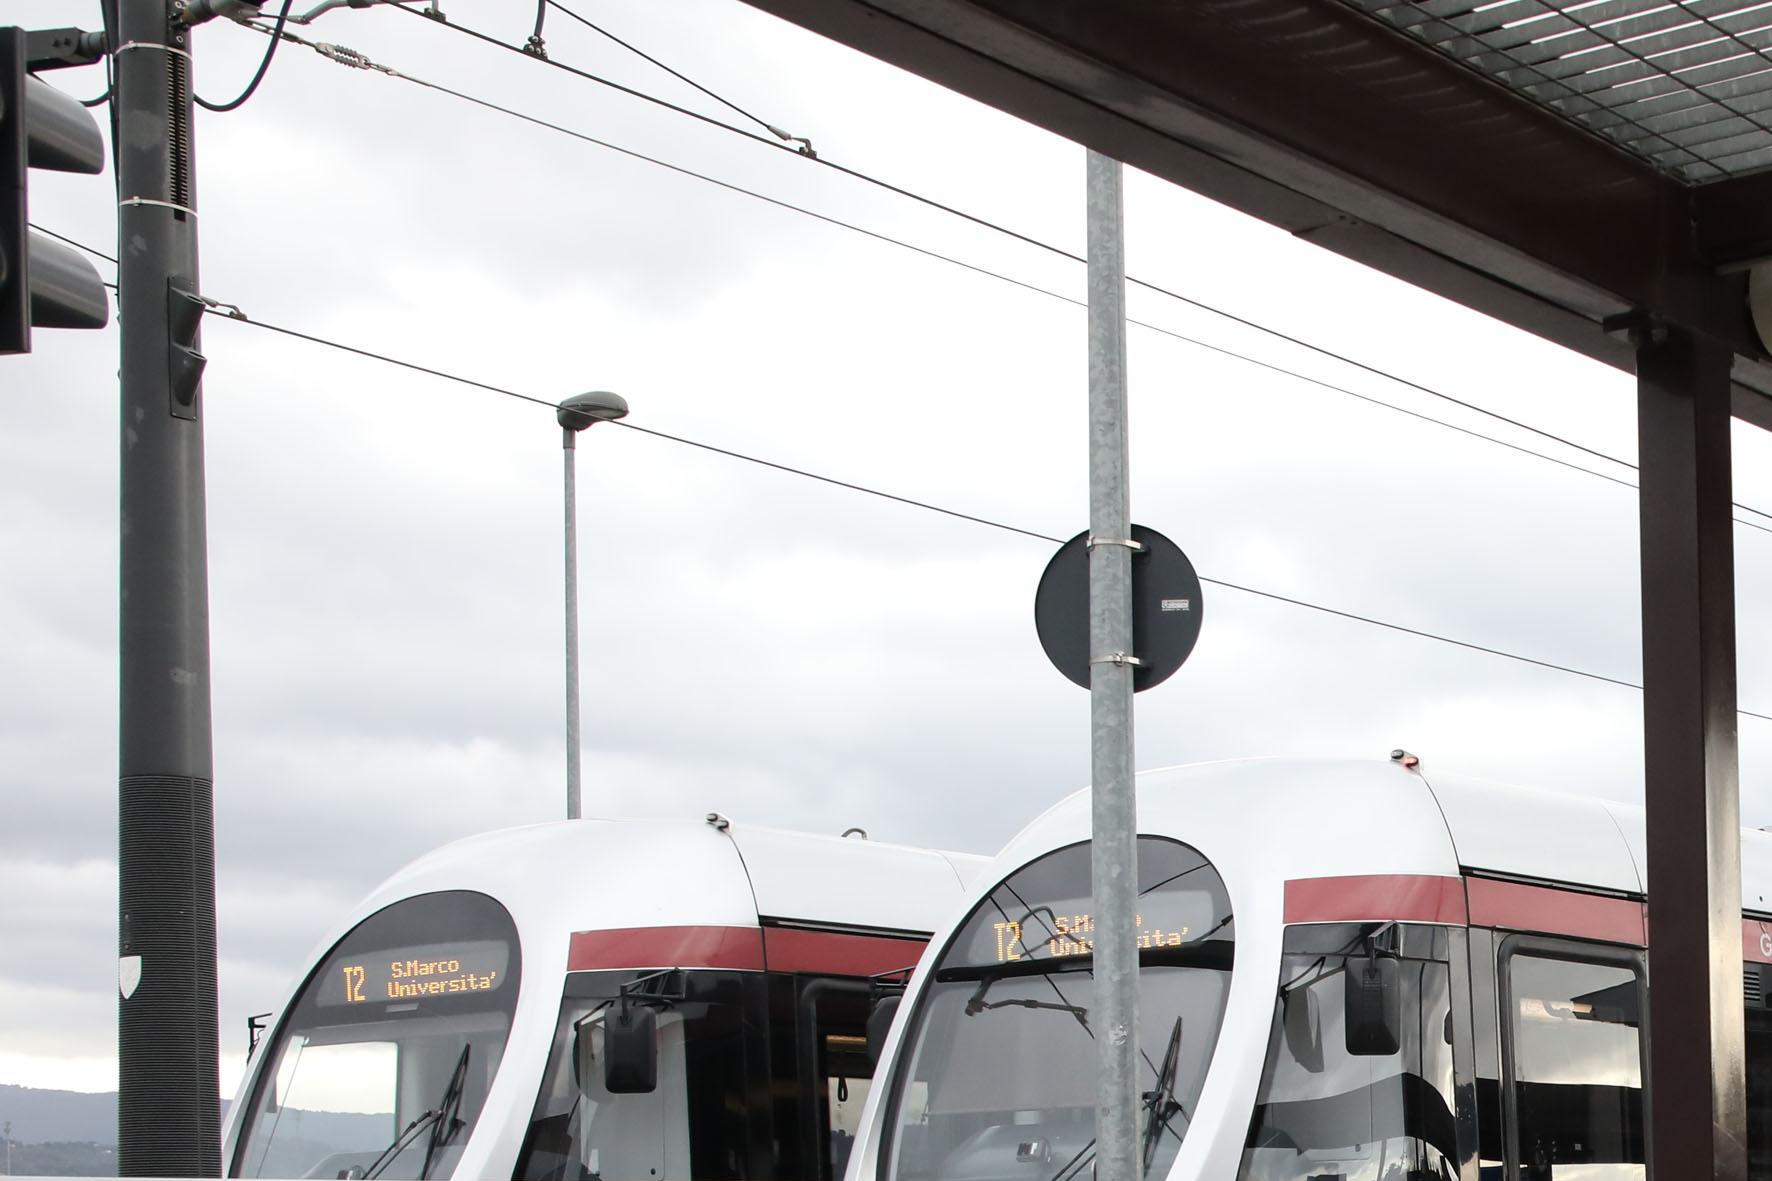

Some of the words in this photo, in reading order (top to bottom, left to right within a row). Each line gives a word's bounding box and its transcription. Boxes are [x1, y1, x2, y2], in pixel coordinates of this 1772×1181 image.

[994, 921, 1021, 961] T2
[1050, 926, 1190, 957] Uniita'
[343, 965, 366, 1002] T2
[391, 959, 460, 978] S.Marco
[387, 971, 497, 998] Universita'
